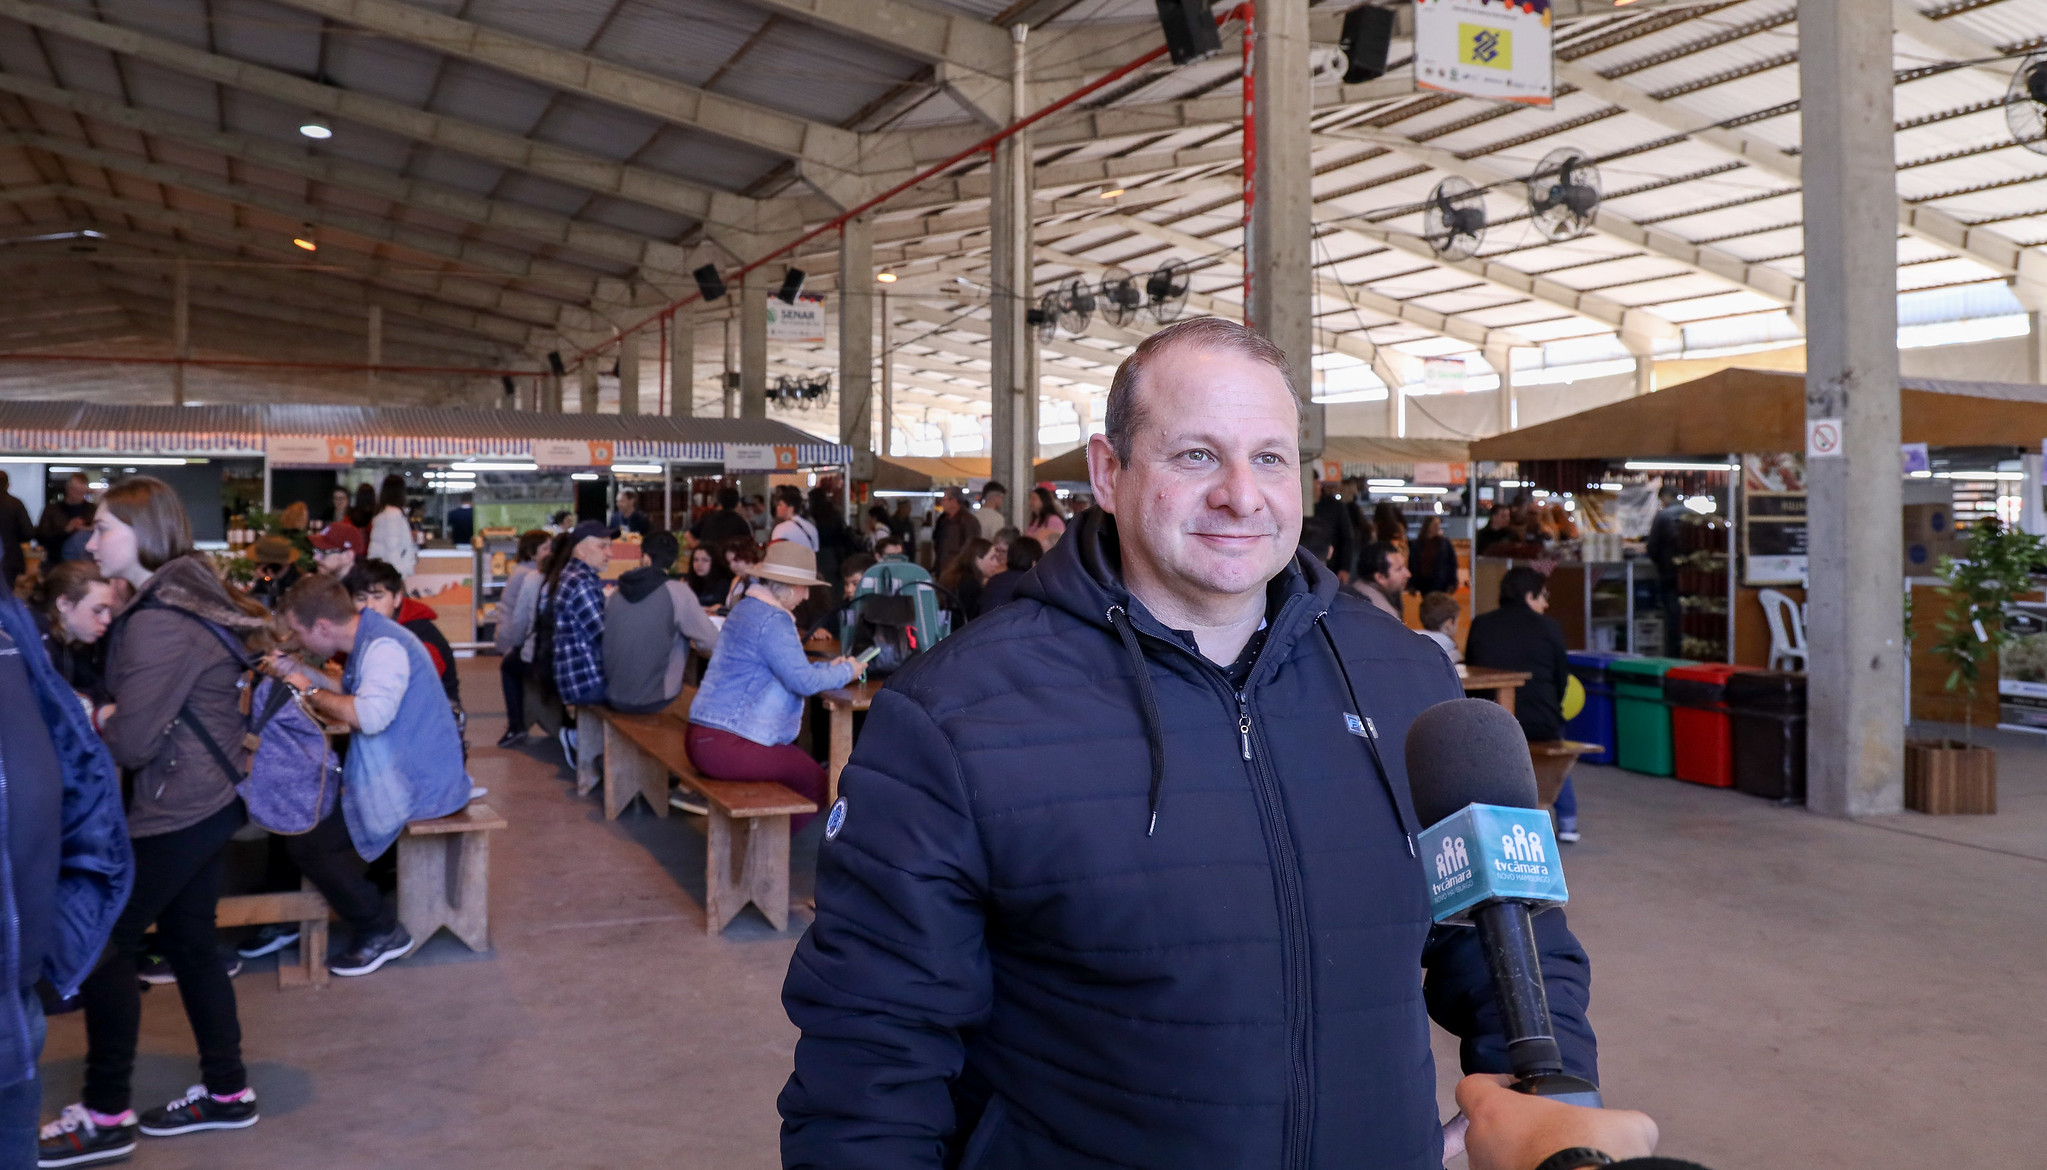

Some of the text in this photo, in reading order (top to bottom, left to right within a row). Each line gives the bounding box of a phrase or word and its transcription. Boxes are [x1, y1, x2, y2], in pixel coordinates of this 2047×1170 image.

[781, 309, 815, 319] SENAR
[1496, 872, 1551, 883] NOVO HAMBURGO
[1433, 880, 1474, 904] NOVO HABURGO
